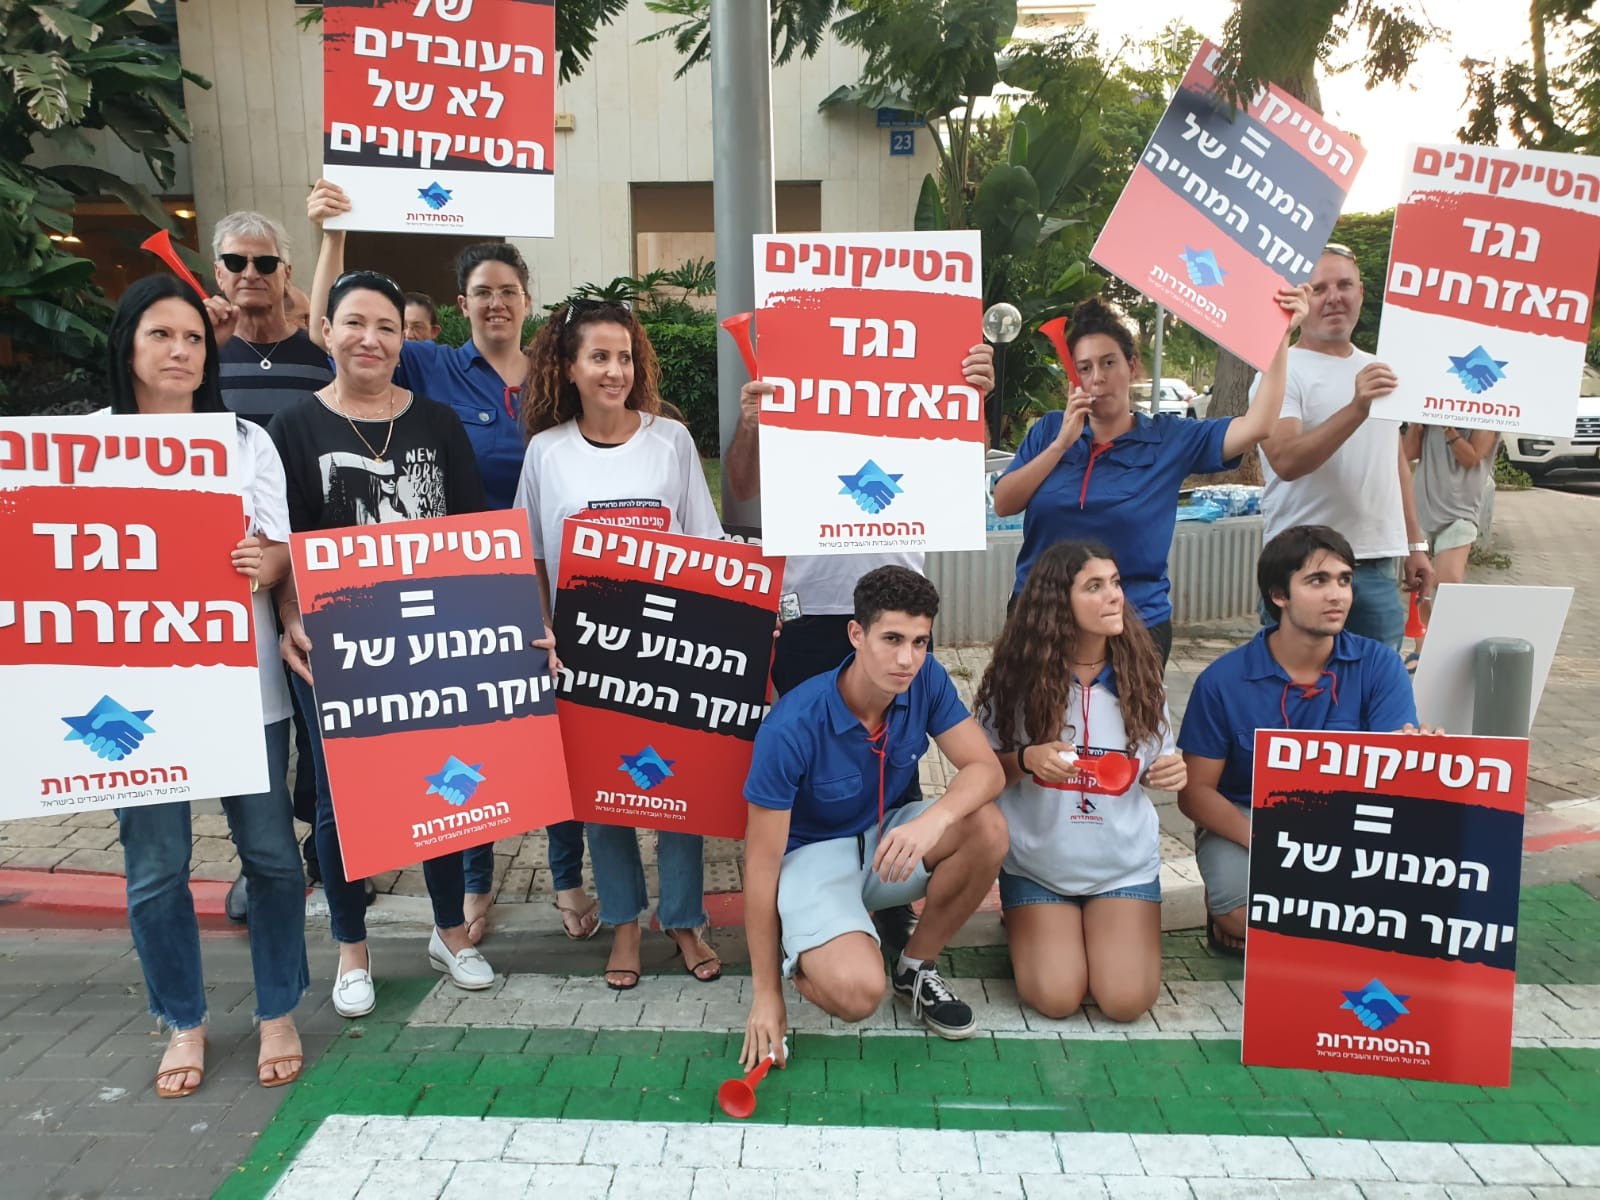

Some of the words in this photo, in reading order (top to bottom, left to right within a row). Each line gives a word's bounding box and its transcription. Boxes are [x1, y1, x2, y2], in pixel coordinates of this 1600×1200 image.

[354, 26, 544, 75] העובדים
[368, 69, 434, 112] של
[446, 81, 505, 119] לא
[330, 121, 545, 170] הטייקונים
[894, 134, 911, 150] 23
[1181, 112, 1228, 159] של
[1145, 143, 1250, 233] המחייה
[1225, 154, 1315, 233] המנוע
[1412, 146, 1600, 203] הטייקונים
[406, 213, 464, 222] ההסתדרות
[1257, 223, 1315, 276] יוקר
[1463, 217, 1541, 263] נגד
[765, 241, 974, 287] הטייקונים
[1150, 265, 1228, 322] ההסתדרות
[1388, 261, 1590, 325] האזרחים
[829, 316, 918, 359] נגד
[760, 375, 982, 422] האזרחים
[1424, 397, 1520, 418] ההסתדרות
[0, 429, 228, 484] הטייקונ
[402, 463, 440, 482] YORK
[406, 448, 436, 463] NEW
[32, 522, 158, 571] נגד
[819, 521, 925, 538] ההסתדרות
[305, 528, 521, 575] הטייקונים
[572, 525, 773, 595] הטייקונים
[0, 600, 249, 645] האזרחי
[576, 612, 631, 651] של
[333, 633, 396, 669] של
[408, 624, 524, 666] המנוע
[636, 631, 748, 677] המנוע
[322, 685, 468, 731] המחייה
[477, 675, 551, 716] יוקר
[554, 667, 679, 713] המחייה
[690, 692, 763, 729] יוקר
[41, 765, 188, 795] ההסתדרות
[1267, 736, 1511, 793] הטייקונים
[77, 794, 115, 804] והעובדים
[117, 790, 152, 800] העובדות
[154, 788, 168, 797] של
[170, 785, 190, 794] הבית
[595, 790, 687, 812] ההסתדרות
[411, 801, 510, 839] ההסתדרות
[1277, 832, 1341, 872] של
[1351, 847, 1490, 892] המנוע
[1251, 893, 1407, 940] המחייה
[1421, 913, 1514, 956] יוקר
[1316, 1032, 1430, 1056] ההסתדרות
